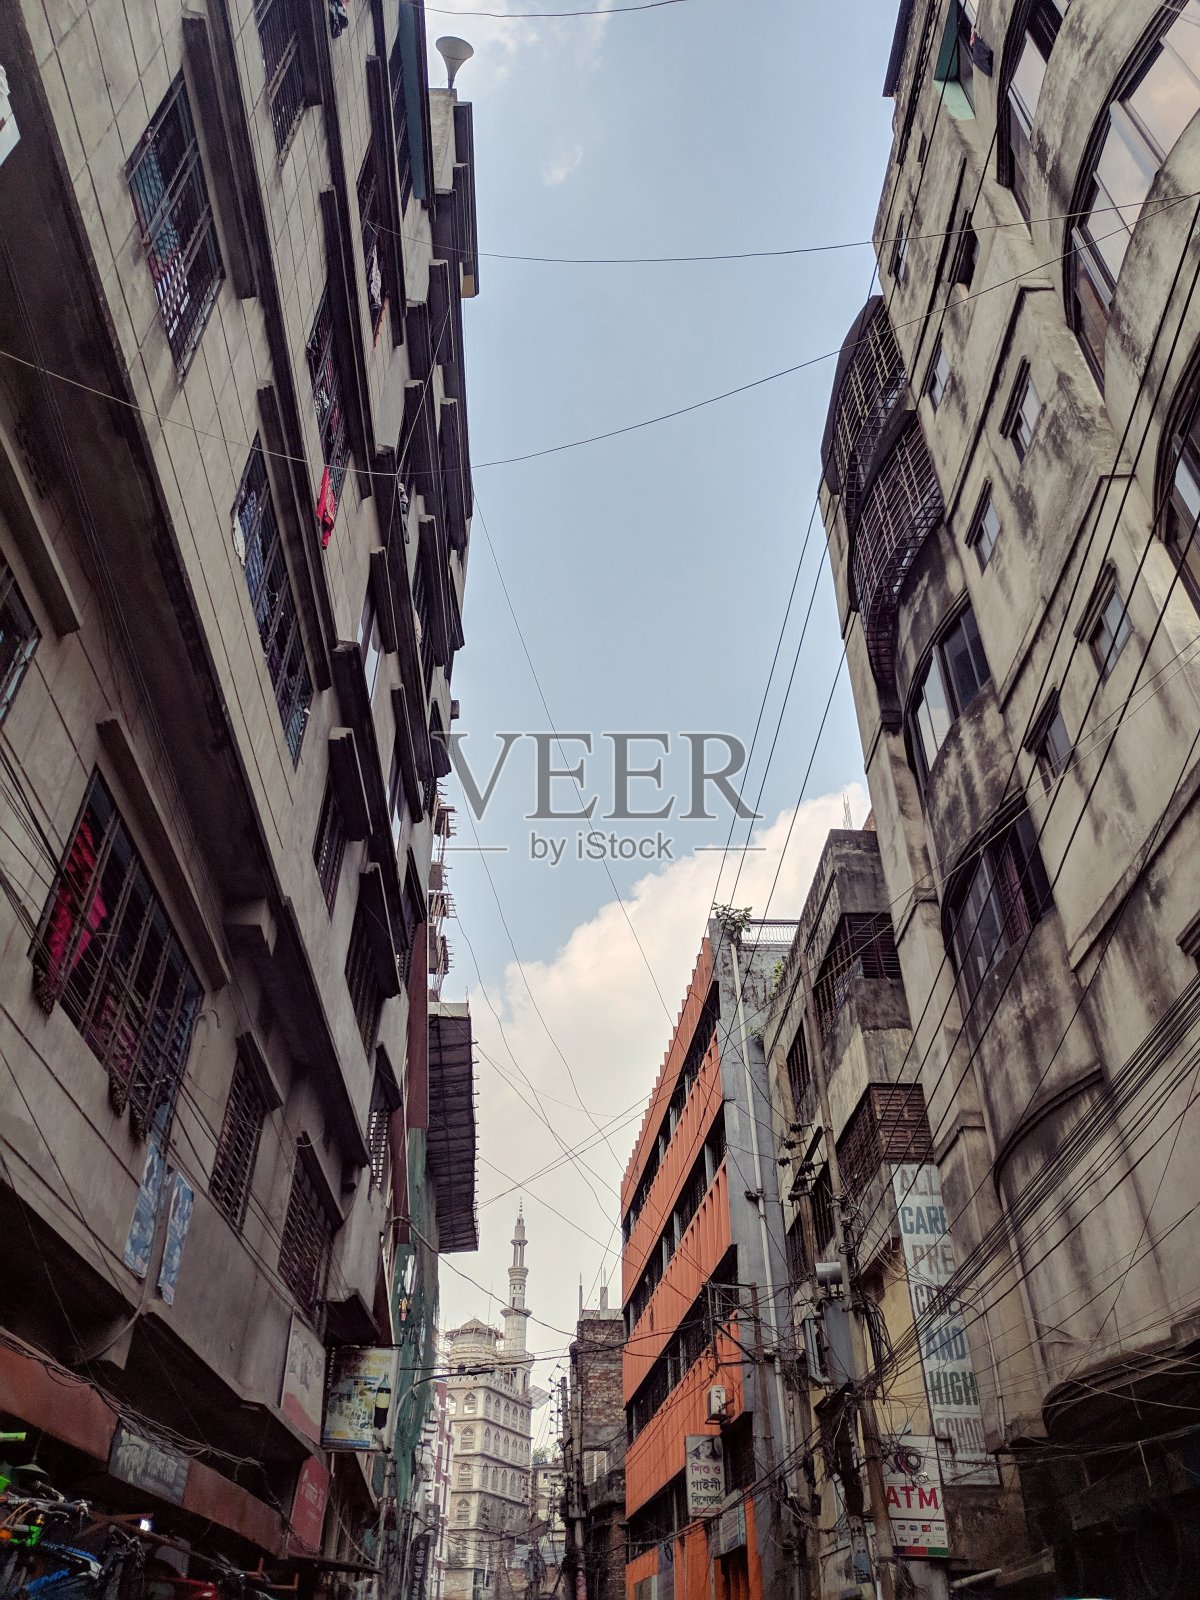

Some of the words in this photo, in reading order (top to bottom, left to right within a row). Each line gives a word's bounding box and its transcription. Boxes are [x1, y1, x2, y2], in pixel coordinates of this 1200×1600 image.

[925, 1326, 967, 1361] AND
[928, 1371, 980, 1406] HIGH
[886, 1485, 939, 1510] ATM
